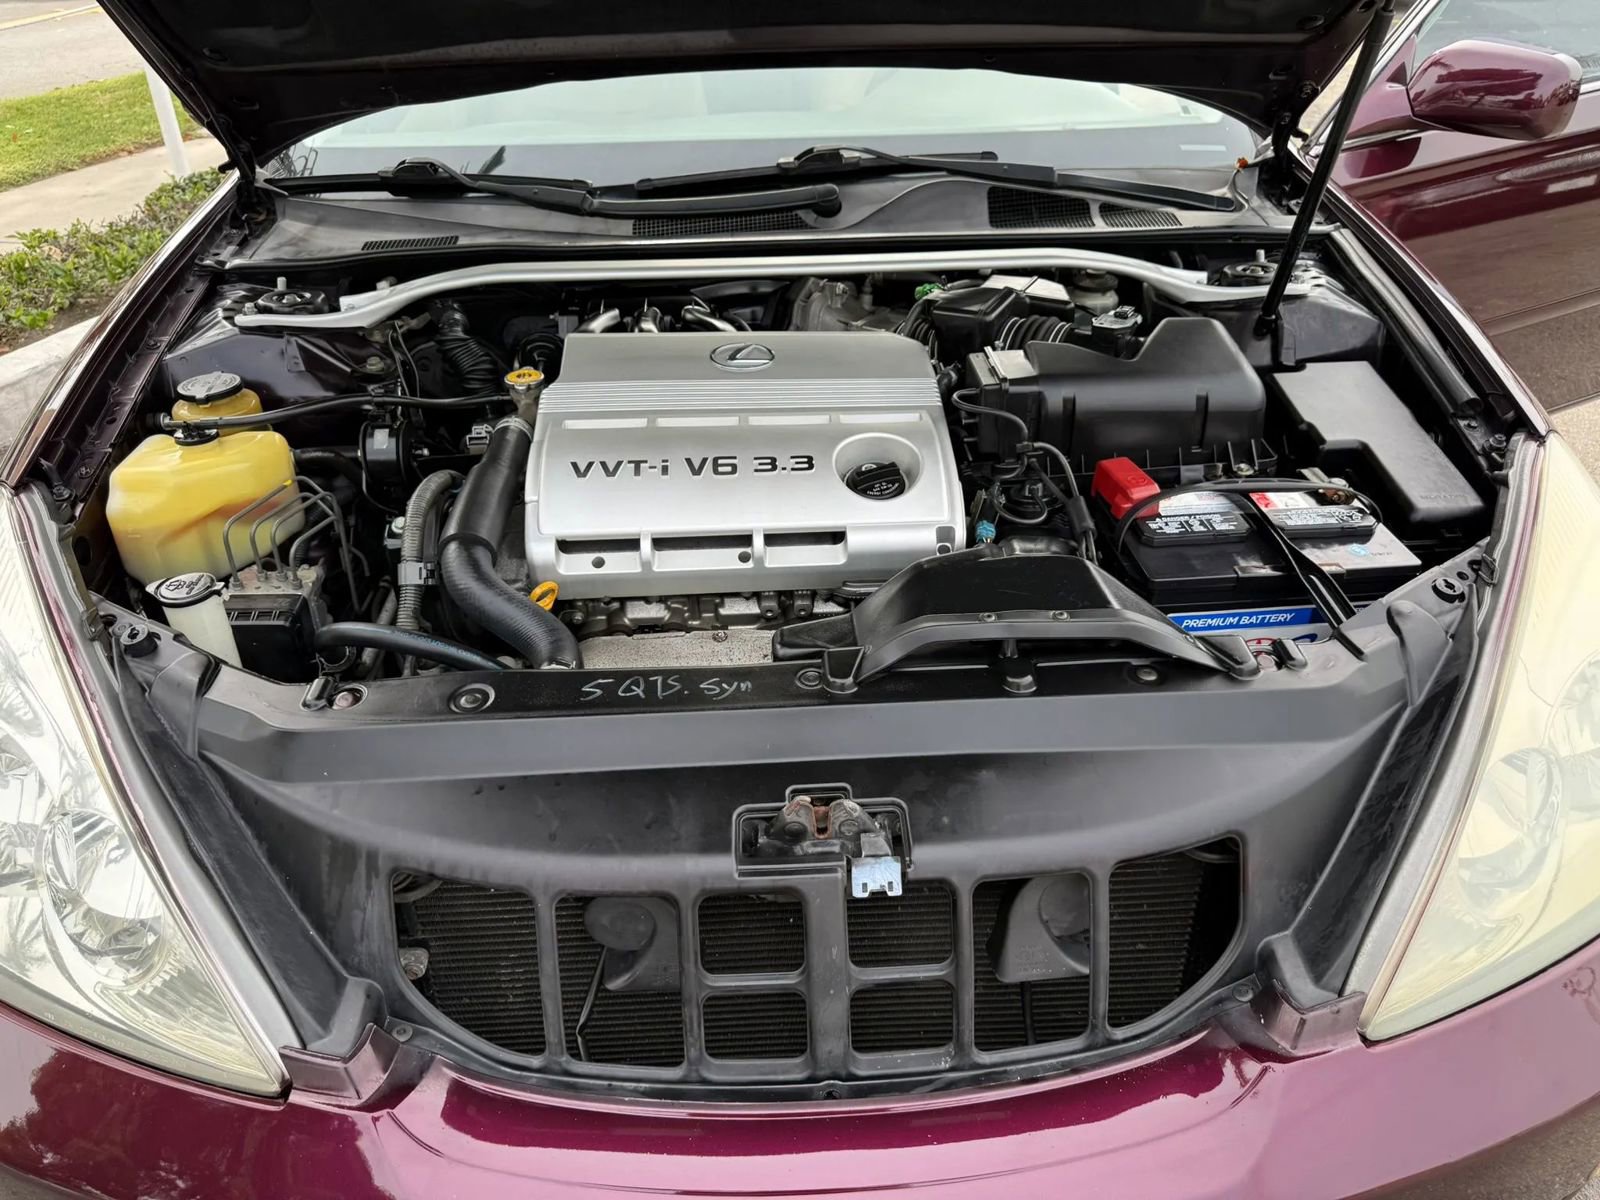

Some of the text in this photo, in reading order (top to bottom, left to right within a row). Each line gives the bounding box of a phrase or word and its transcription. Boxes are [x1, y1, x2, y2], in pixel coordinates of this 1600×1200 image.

[570, 455, 815, 479] VVT-i V6 3.3
[1181, 612, 1296, 629] PREMIUM BATTERY
[699, 677, 753, 701] Syn
